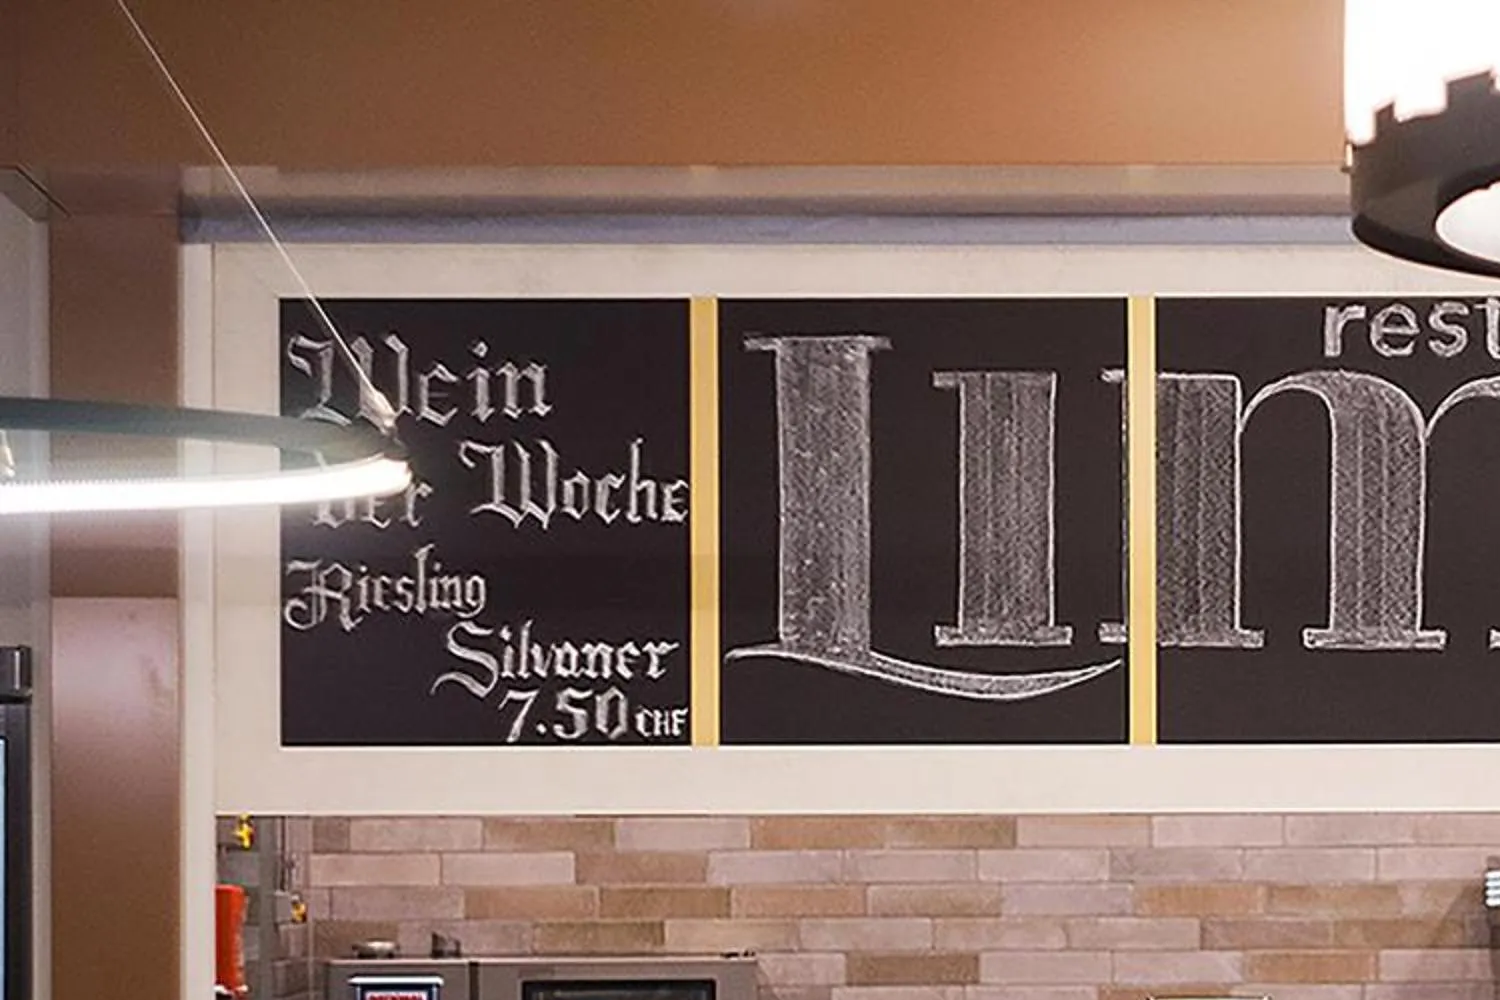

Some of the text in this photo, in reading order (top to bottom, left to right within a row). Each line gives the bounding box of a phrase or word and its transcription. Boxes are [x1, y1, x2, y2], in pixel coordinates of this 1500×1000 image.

[287, 332, 554, 430] Wein
[459, 438, 690, 529] Woche
[284, 543, 487, 631] Riesling
[430, 619, 680, 698] Silvaner
[498, 687, 689, 742] 7.50 CHF
